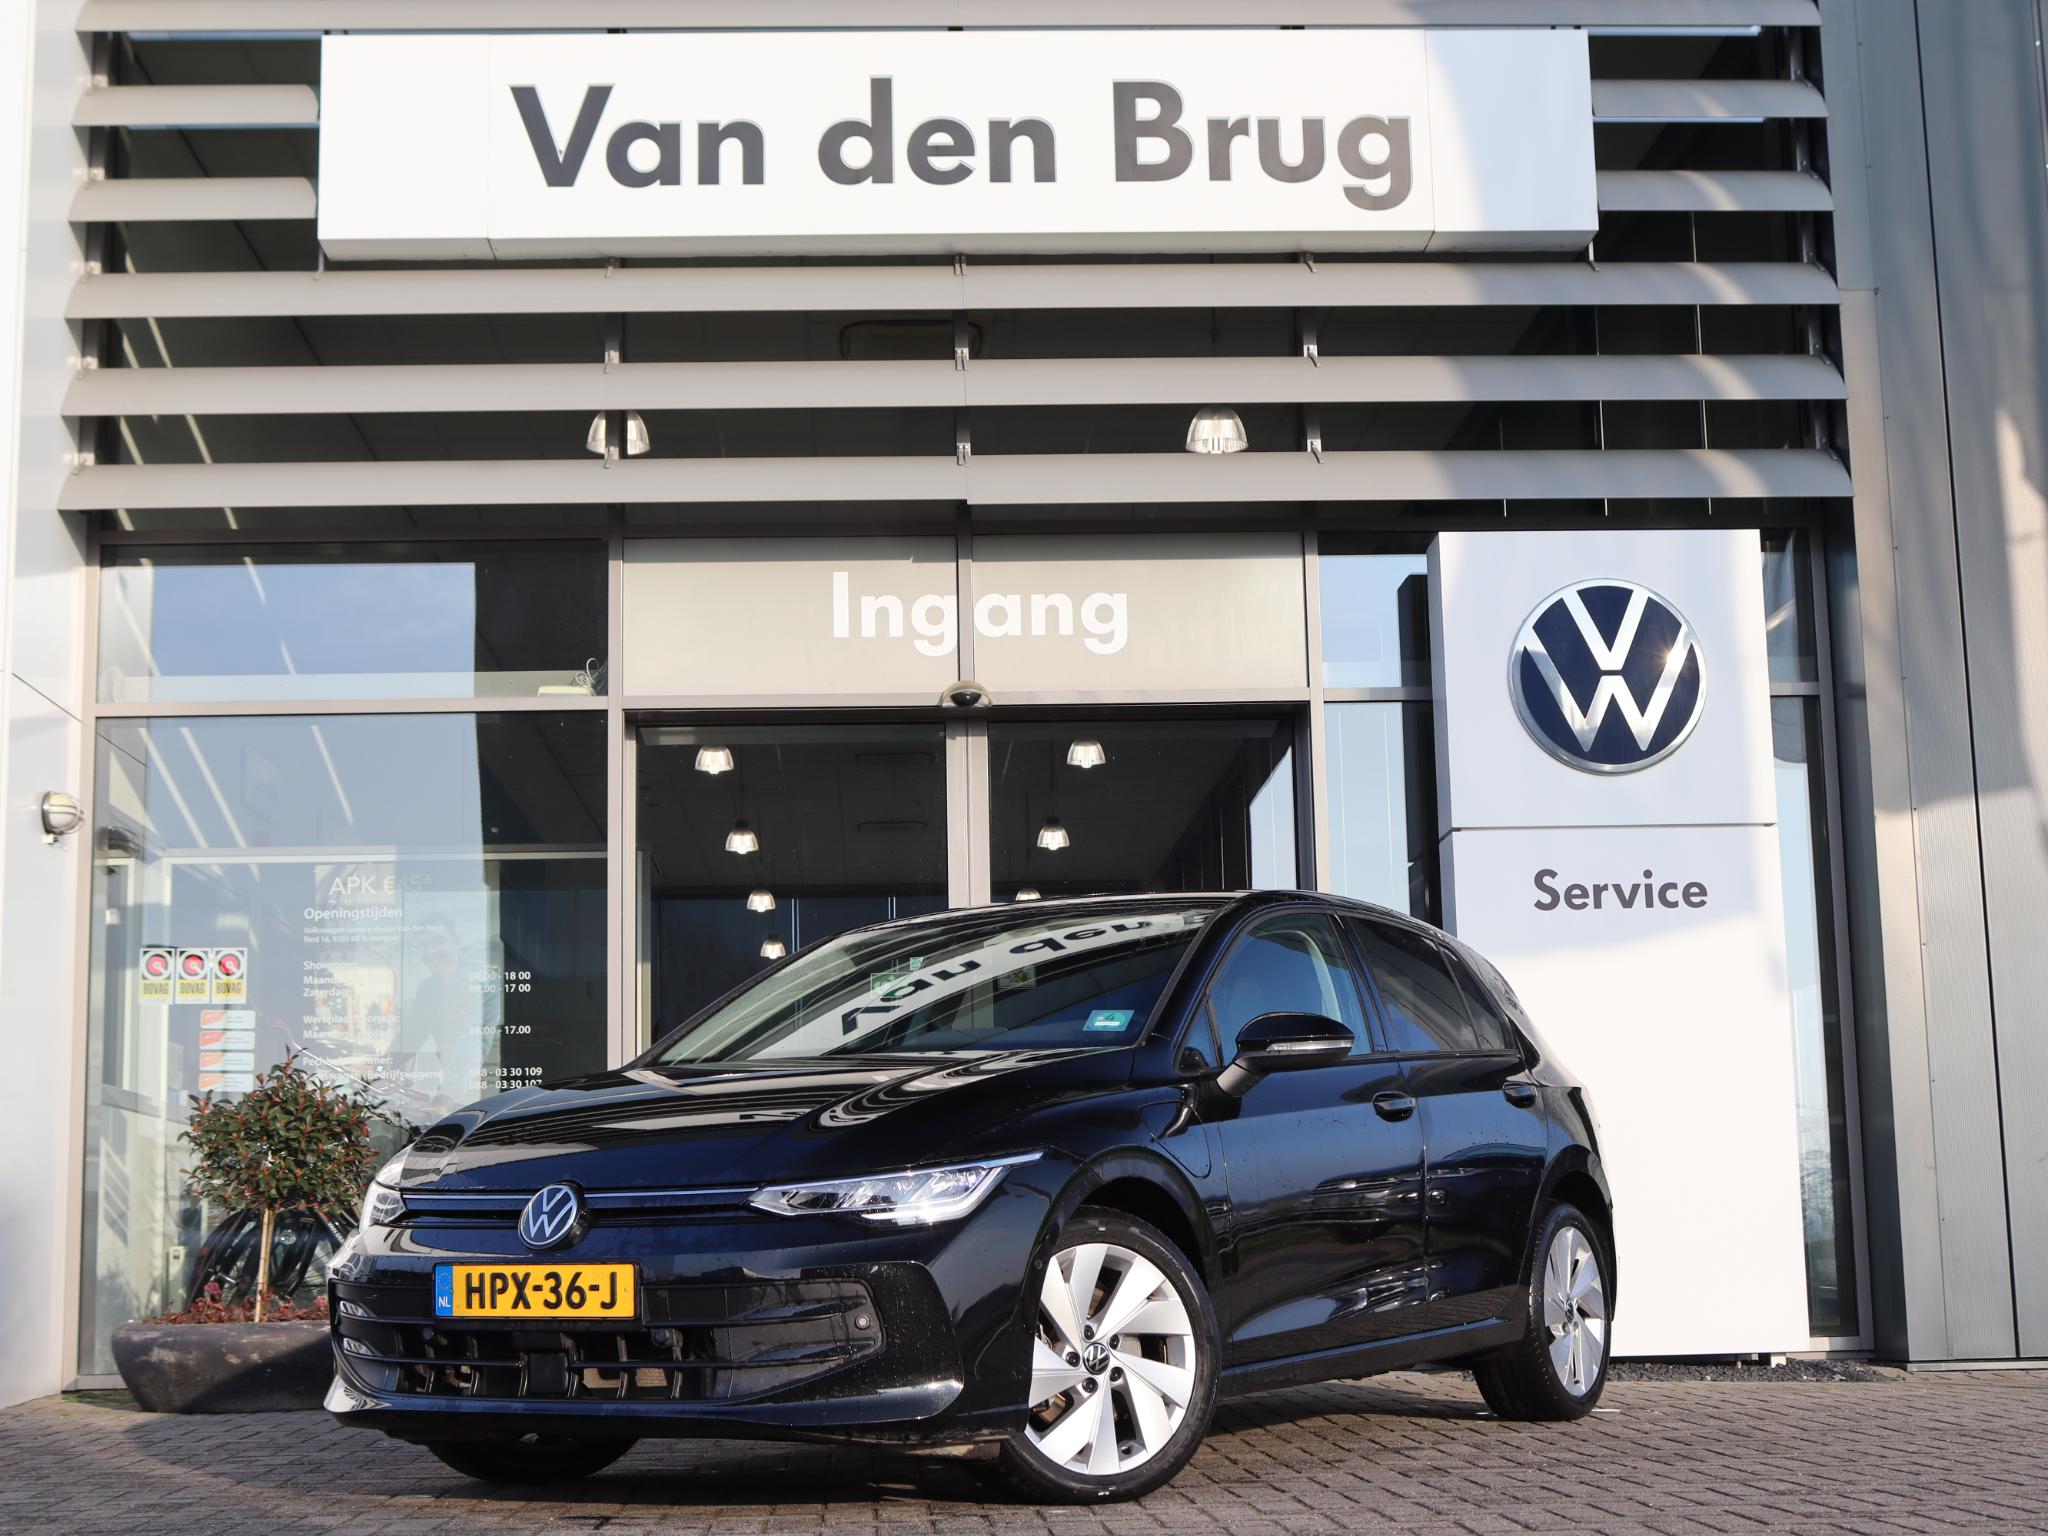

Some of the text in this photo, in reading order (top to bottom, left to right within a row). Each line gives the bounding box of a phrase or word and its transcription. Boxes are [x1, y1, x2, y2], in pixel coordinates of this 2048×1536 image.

[509, 74, 1414, 211] Van den Brug
[832, 571, 1128, 657] Ingang
[328, 876, 376, 895] APK
[1533, 868, 1708, 911] Service
[303, 906, 402, 921] Openingstijden
[143, 982, 169, 994] BOVAG
[179, 982, 206, 994] BOVAG
[216, 982, 242, 994] BOVAG
[504, 1025, 531, 1035] 17.00
[495, 1068, 508, 1077] 03
[509, 1067, 522, 1077] 30
[525, 1067, 543, 1076] 109
[495, 1080, 508, 1090] 03
[509, 1080, 522, 1089] 30
[464, 1270, 619, 1311] HPX-36-J
[438, 1298, 452, 1308] NL
